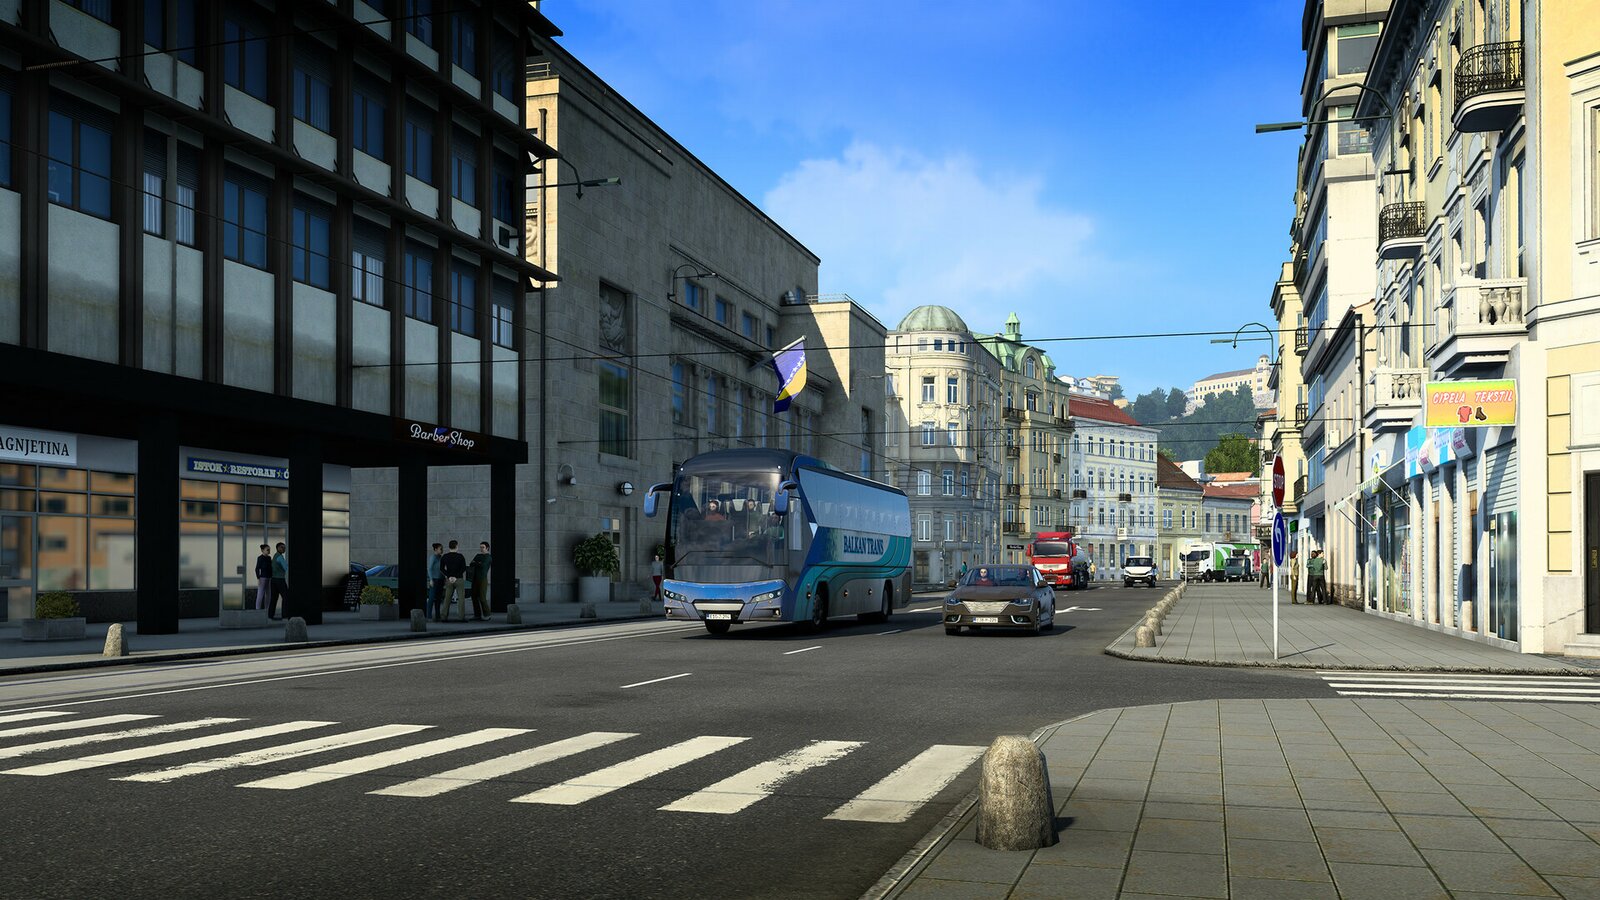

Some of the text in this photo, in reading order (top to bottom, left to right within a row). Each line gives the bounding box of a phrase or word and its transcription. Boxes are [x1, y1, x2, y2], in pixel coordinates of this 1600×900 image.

[1433, 389, 1513, 404] CIPELA TEKSTIL
[193, 461, 222, 473] ISTOK
[230, 465, 275, 477] RESTORAN
[1274, 473, 1284, 489] STOP
[843, 535, 884, 555] BALKAN TRANS
